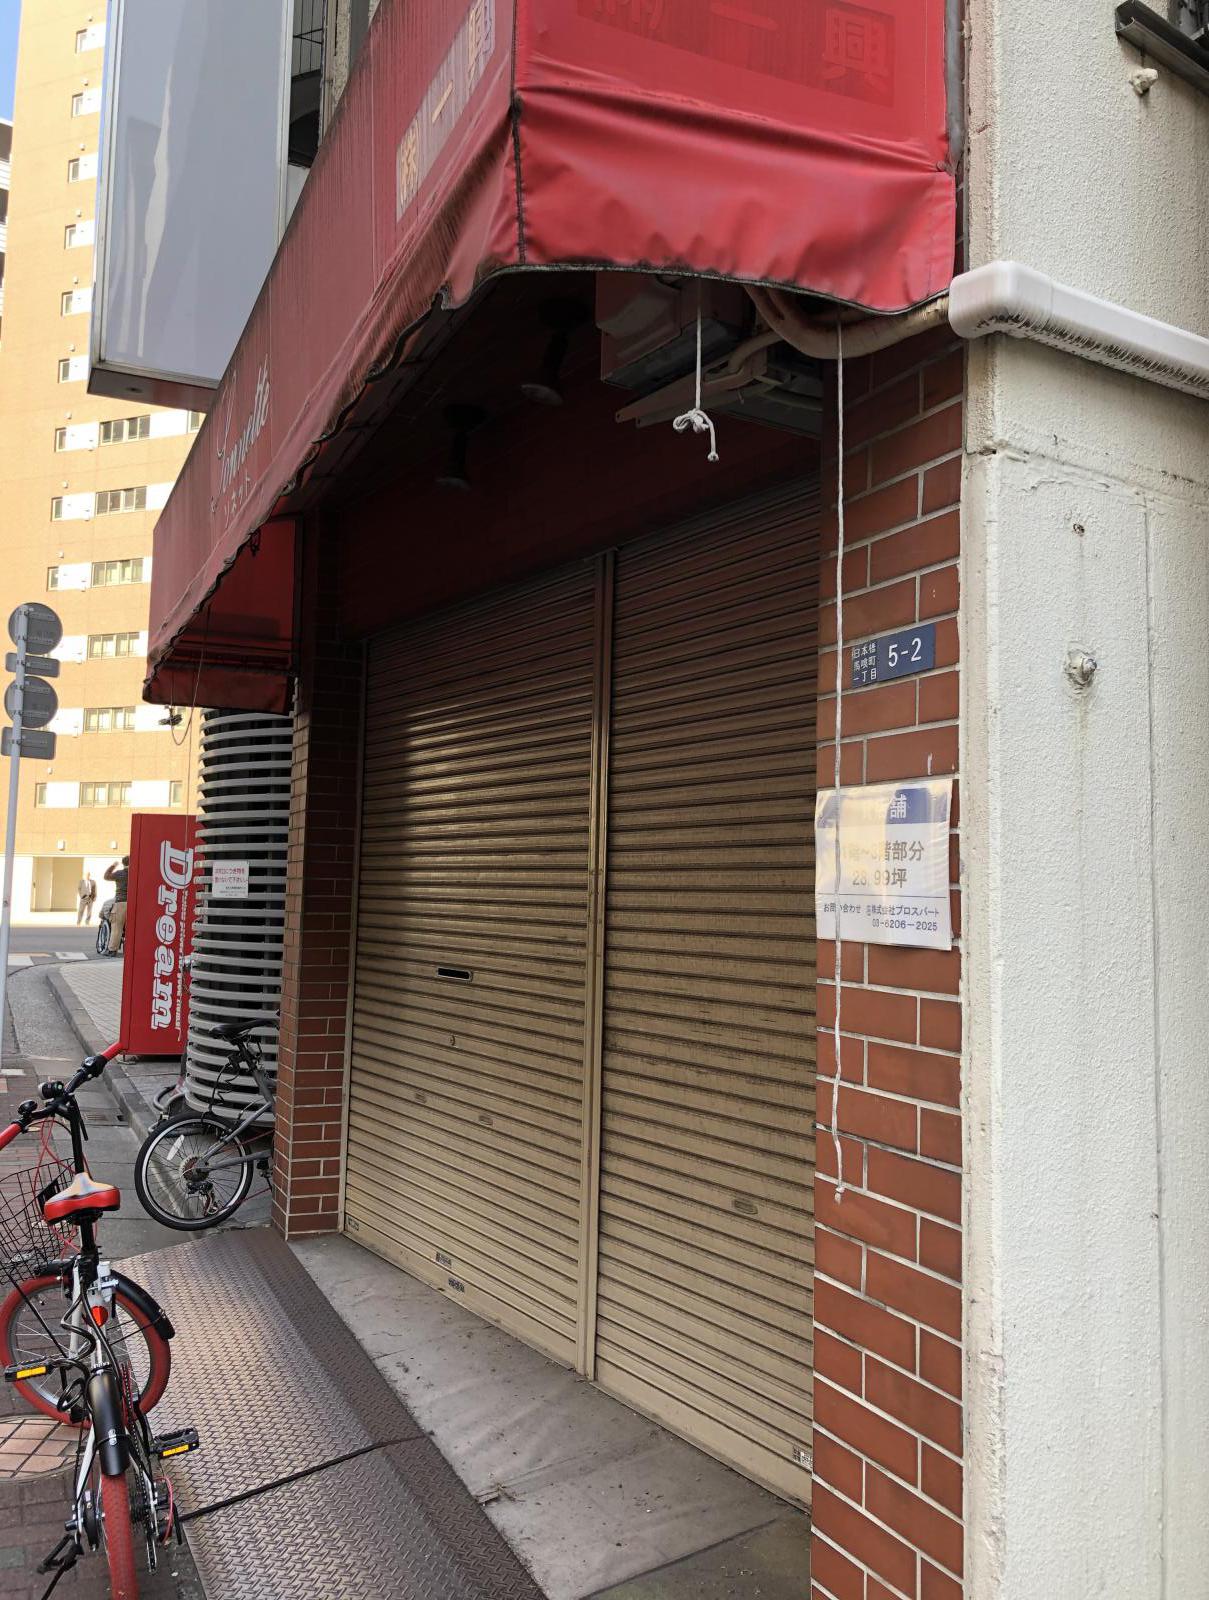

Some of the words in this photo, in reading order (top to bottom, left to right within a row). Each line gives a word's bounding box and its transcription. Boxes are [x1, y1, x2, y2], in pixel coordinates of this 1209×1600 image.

[852, 643, 876, 659] 日本橋
[888, 637, 922, 667] 5-2
[853, 668, 877, 682] 一丁目
[150, 839, 194, 1030] Dream
